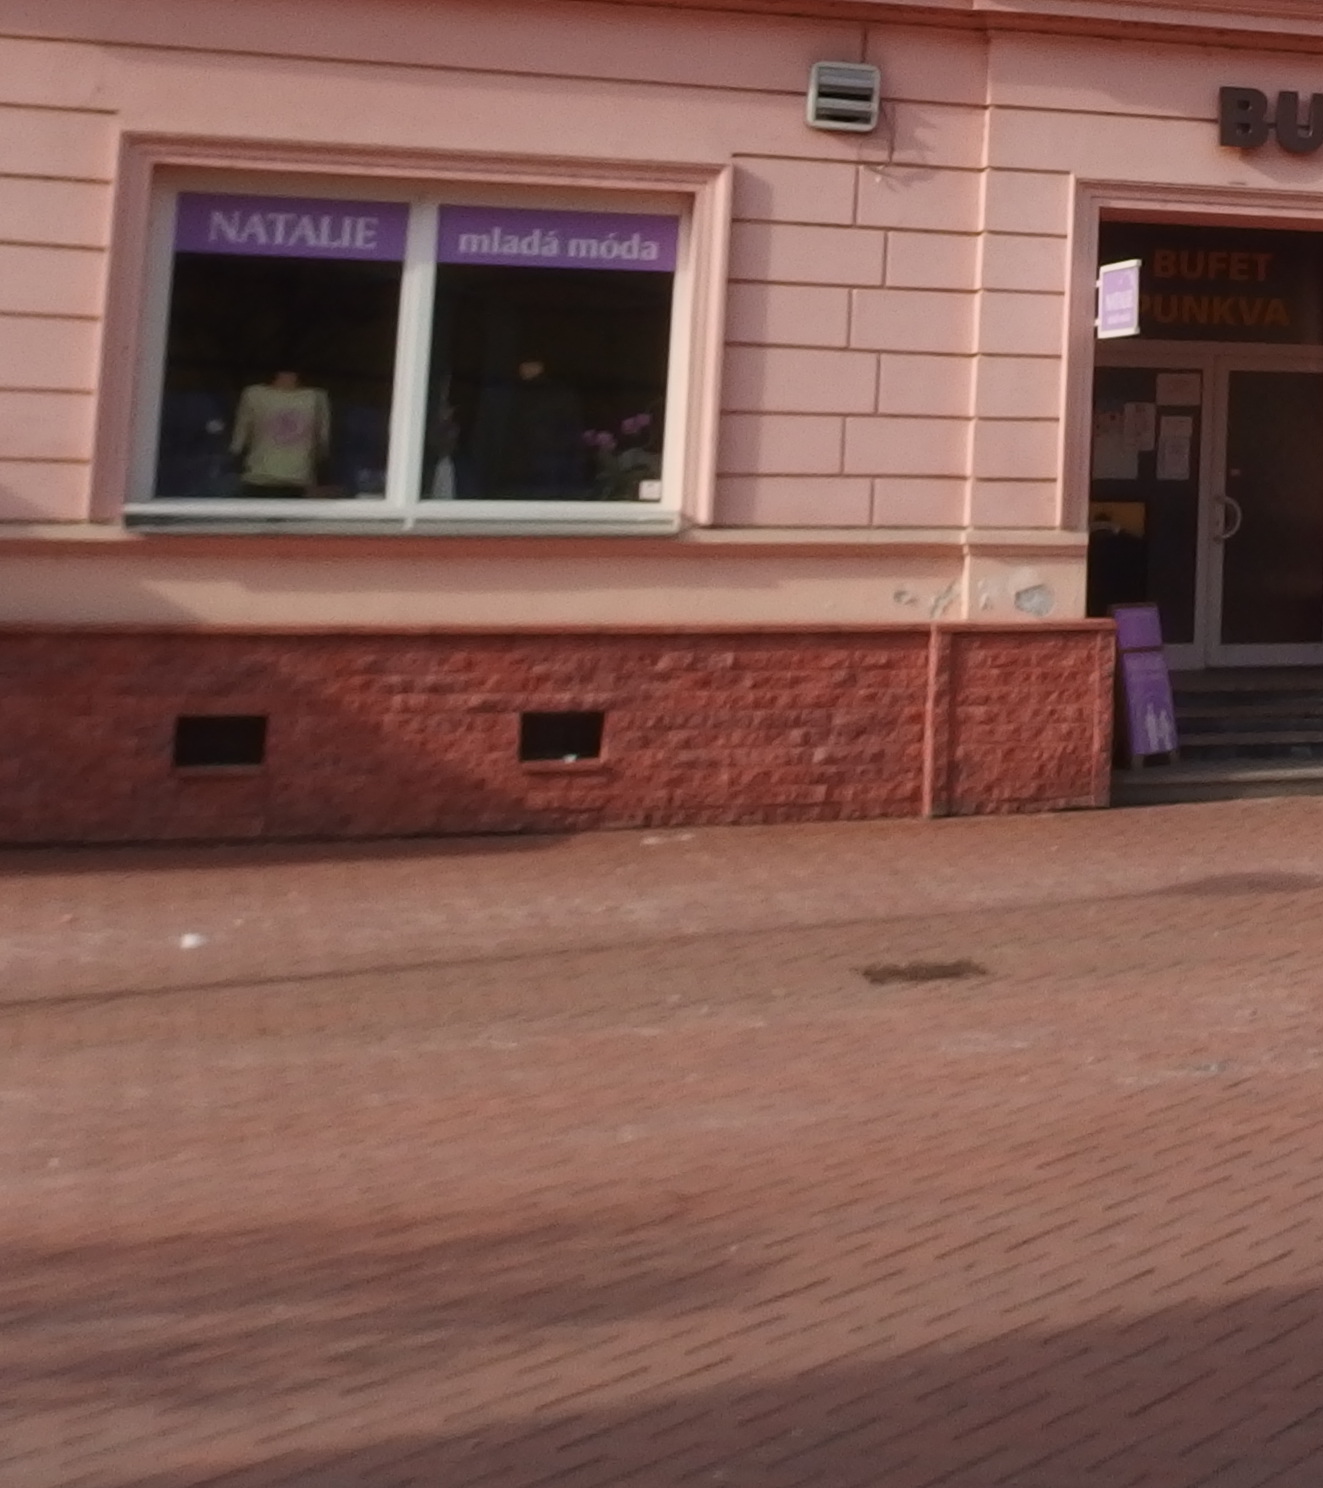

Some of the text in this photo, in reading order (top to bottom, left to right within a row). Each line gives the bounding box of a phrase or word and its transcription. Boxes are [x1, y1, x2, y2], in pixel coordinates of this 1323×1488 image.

[207, 210, 379, 252] NATALIE
[458, 226, 660, 262] mladá móda
[1152, 248, 1274, 281] BUFET
